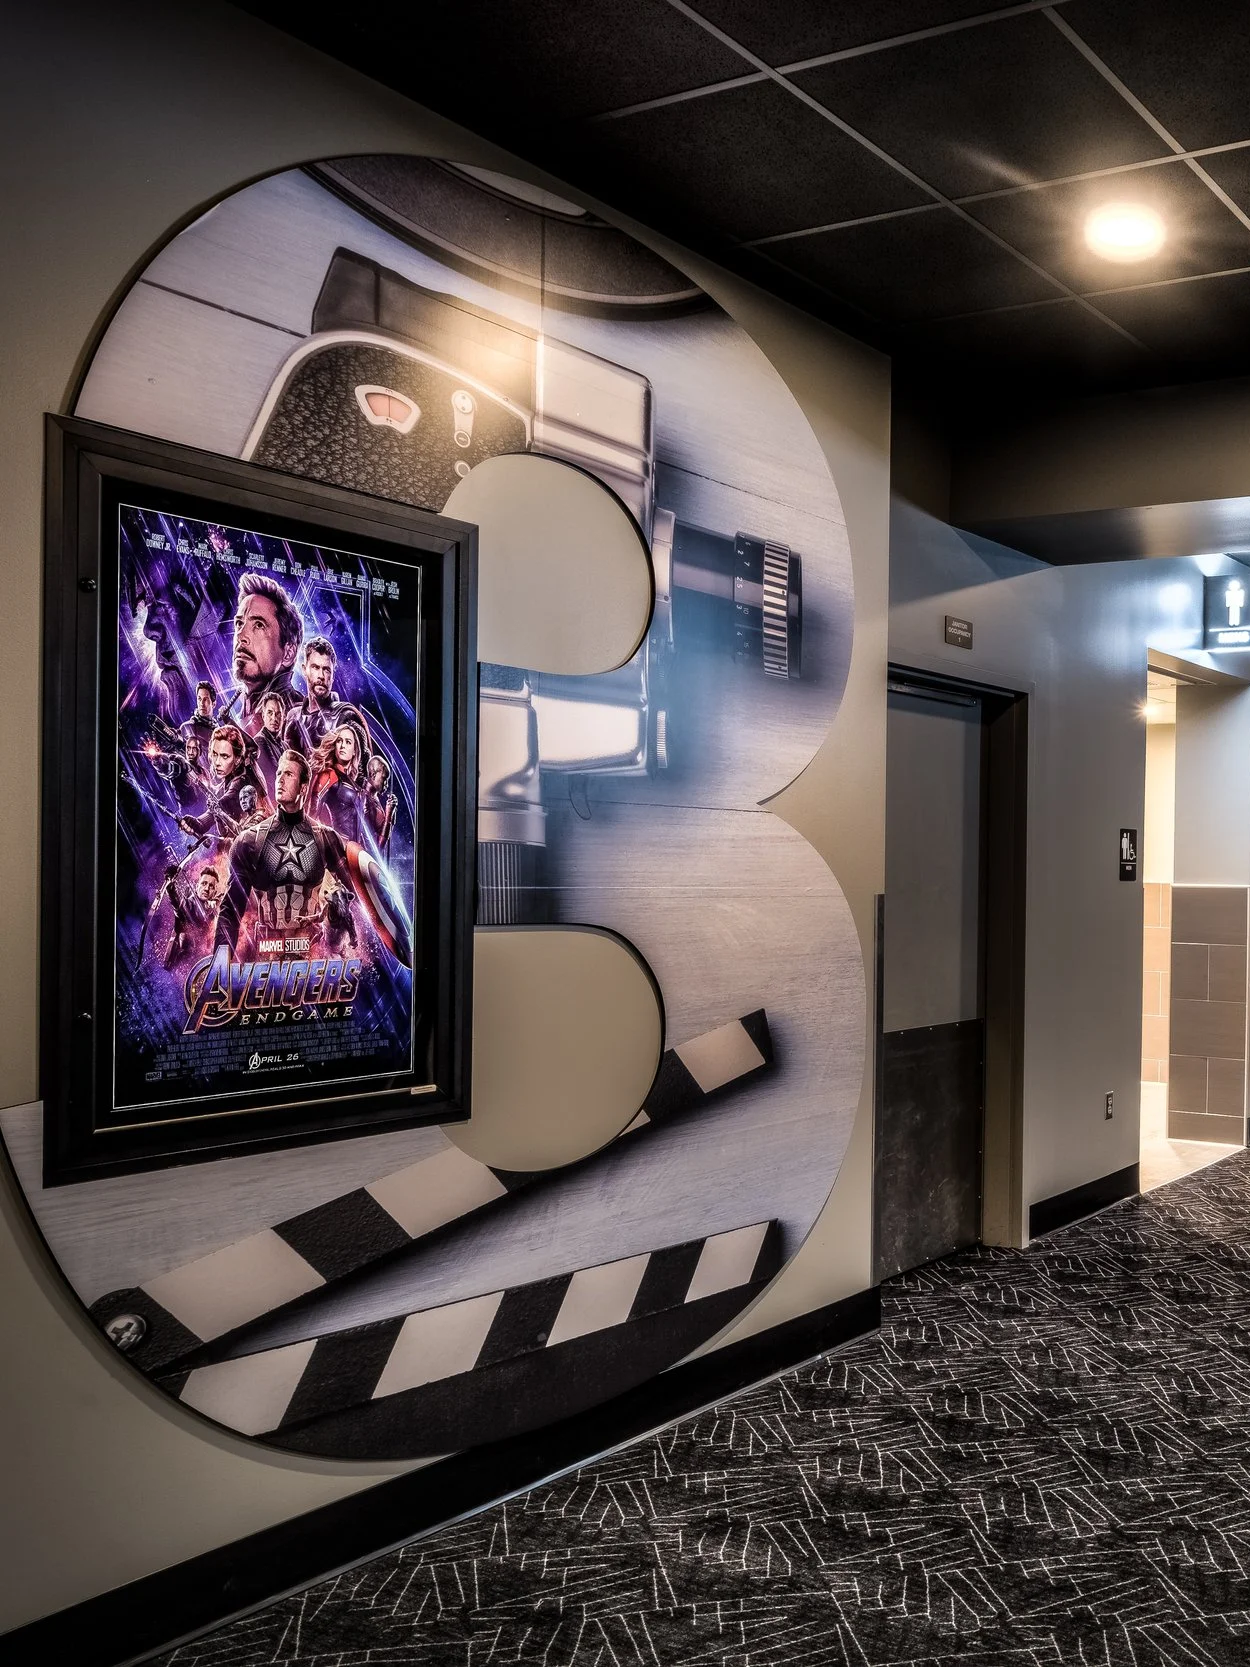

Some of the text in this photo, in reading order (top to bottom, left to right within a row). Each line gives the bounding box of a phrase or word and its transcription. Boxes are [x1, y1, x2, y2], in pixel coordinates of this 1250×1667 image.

[948, 627, 971, 638] OCCUPANCY
[952, 620, 968, 630] JANITOR
[259, 937, 310, 953] MARVEL STUDIOS
[182, 944, 362, 1035] AVENGERS
[239, 1006, 354, 1026] ENDGAME
[249, 1052, 283, 1070] APRIL
[286, 1052, 299, 1061] 26
